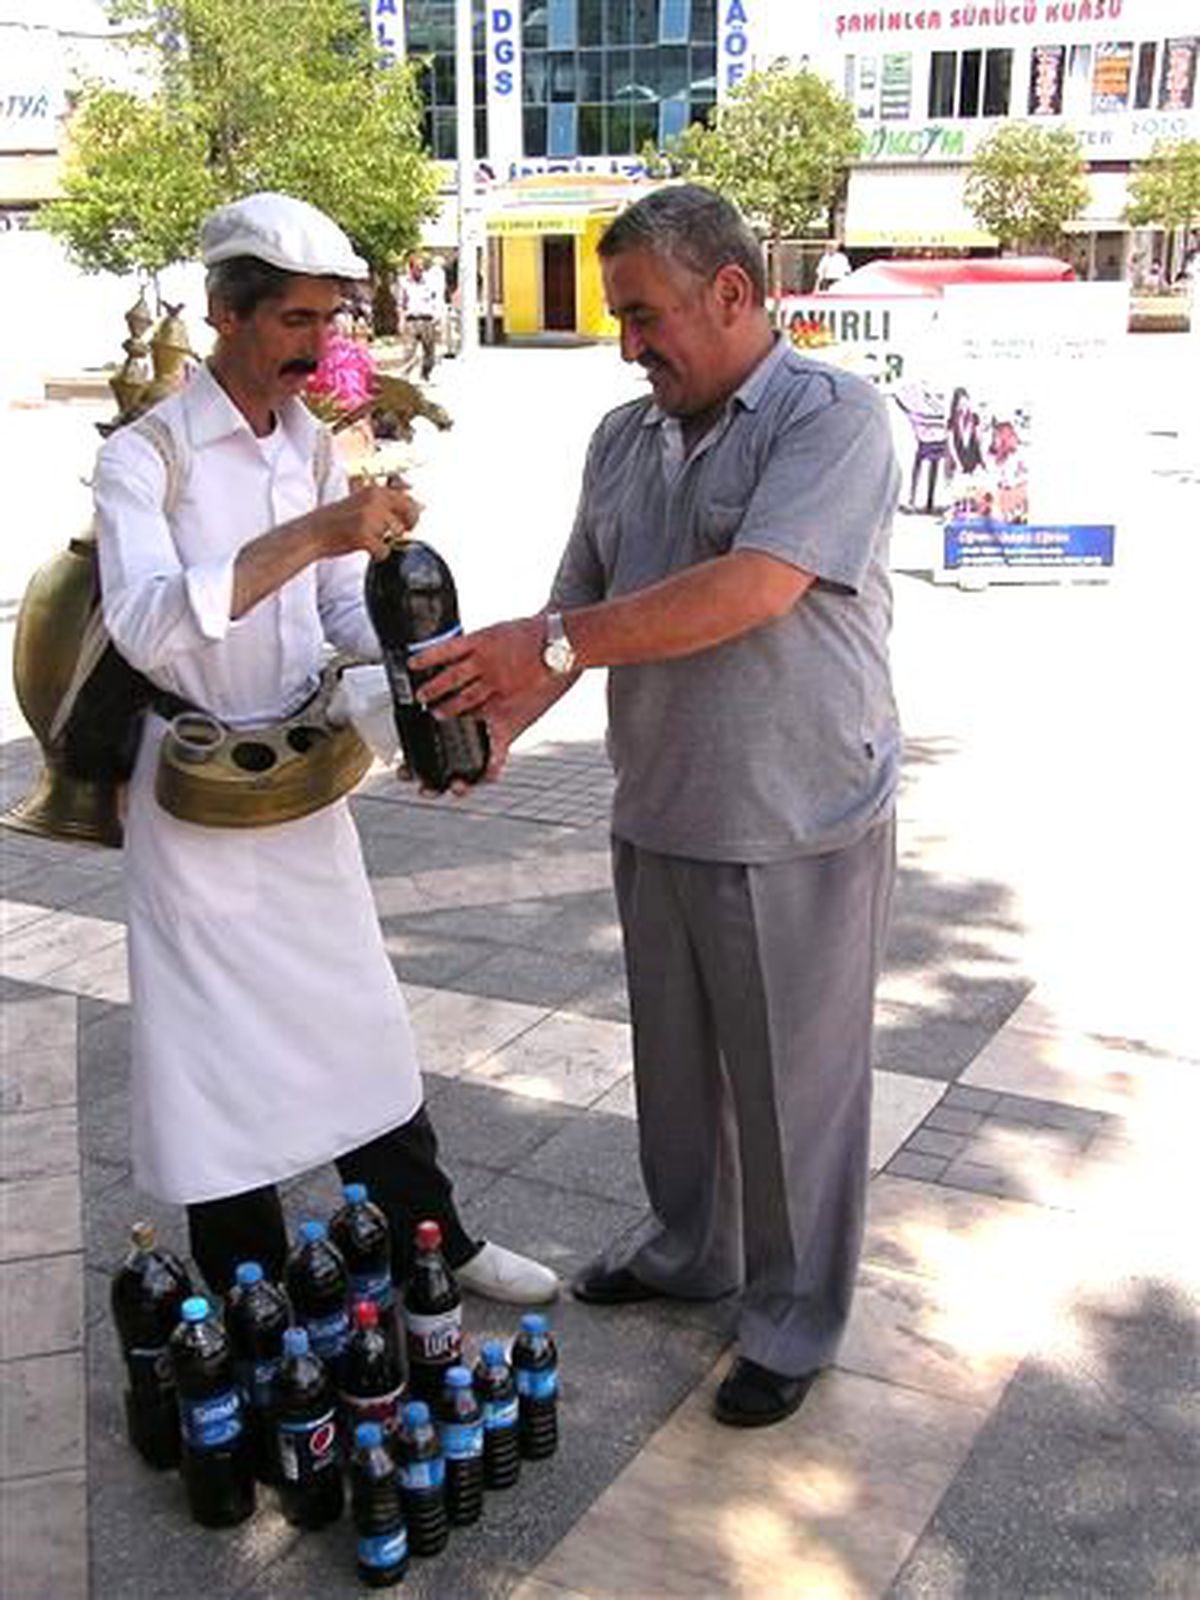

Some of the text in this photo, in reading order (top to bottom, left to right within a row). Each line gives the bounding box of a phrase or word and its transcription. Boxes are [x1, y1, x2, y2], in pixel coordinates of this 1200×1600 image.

[950, 0, 1039, 27] SÜRÜCÜ
[1045, 0, 1124, 22] KURSU
[492, 9, 515, 95] DGS
